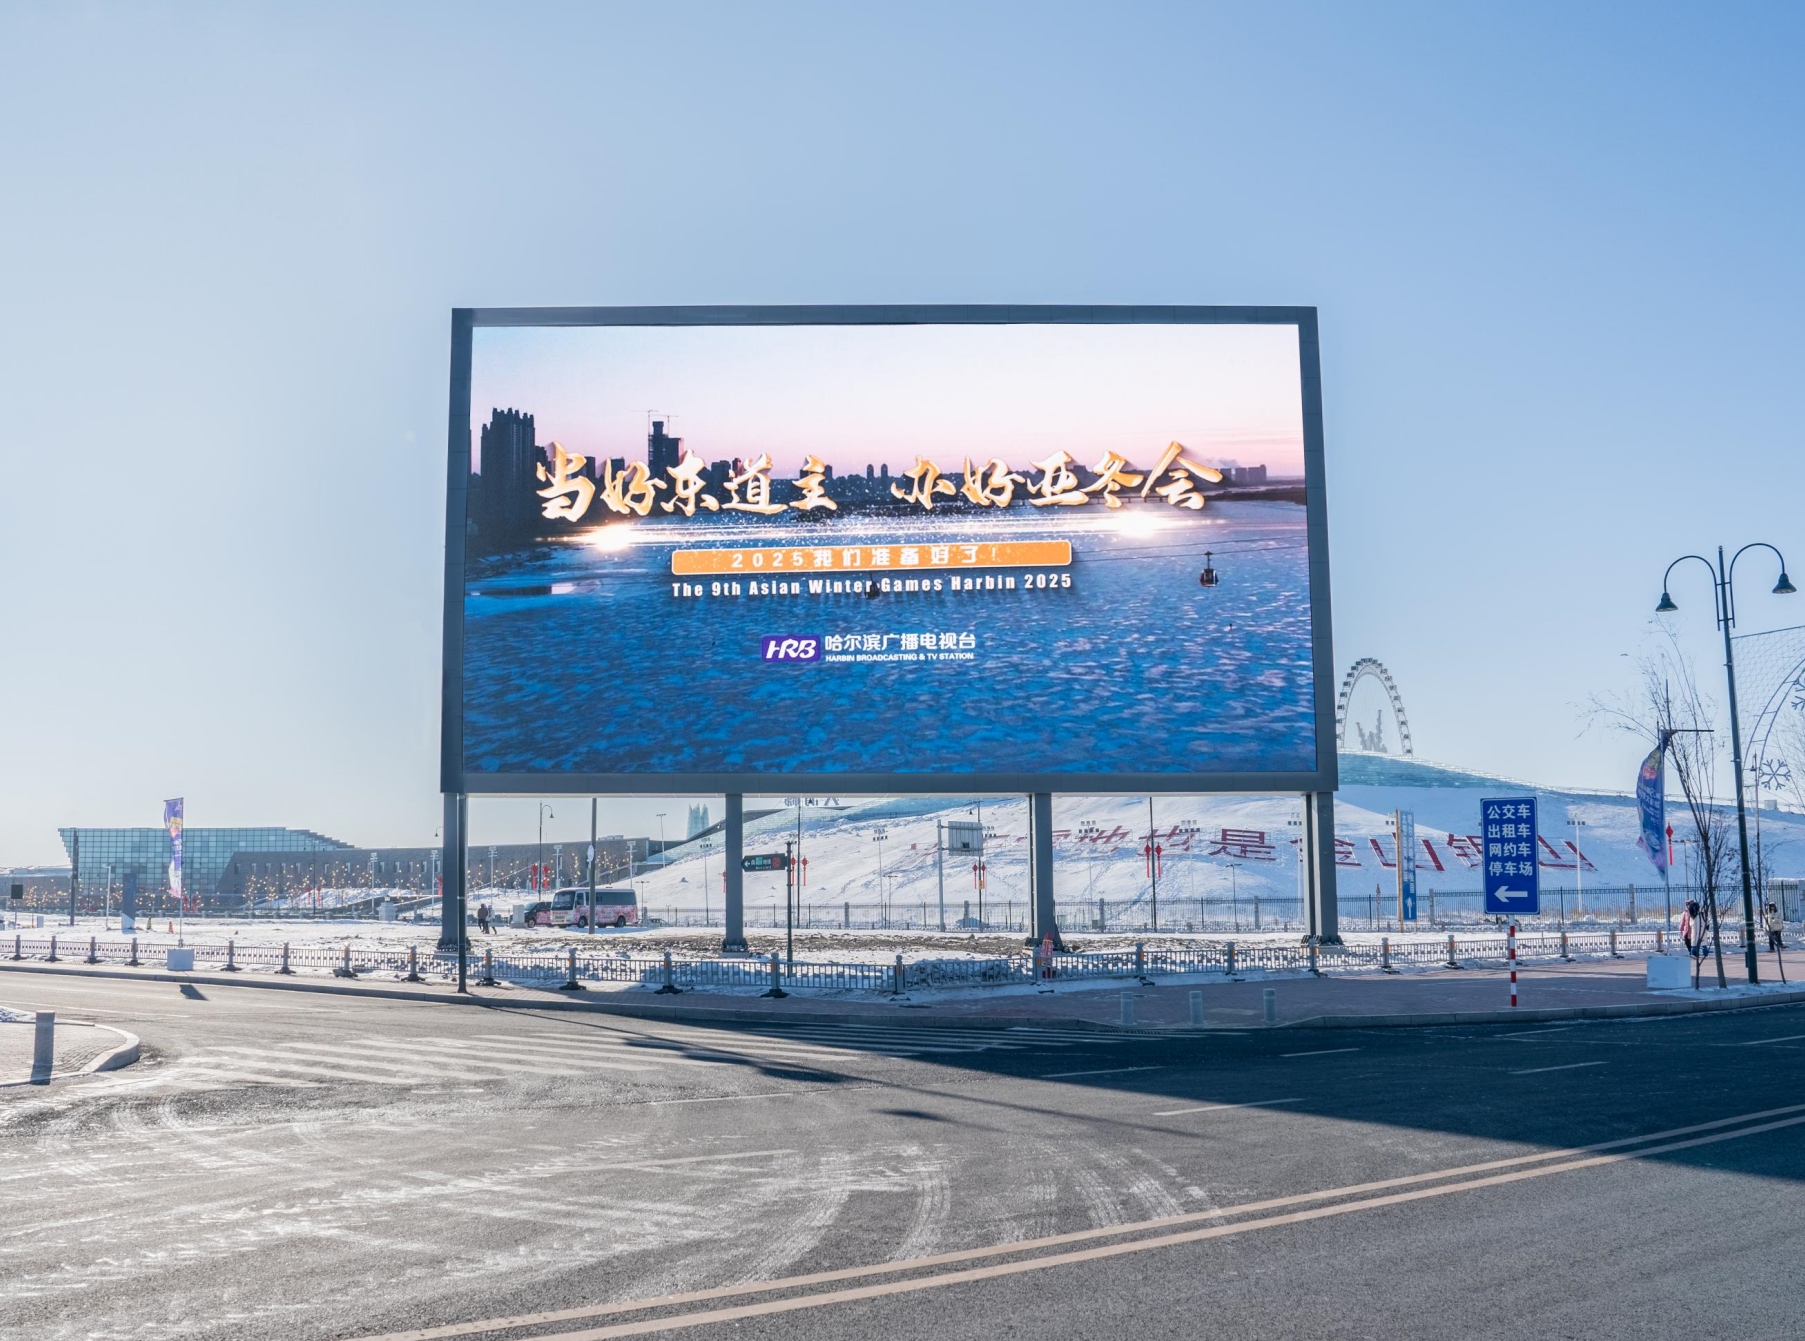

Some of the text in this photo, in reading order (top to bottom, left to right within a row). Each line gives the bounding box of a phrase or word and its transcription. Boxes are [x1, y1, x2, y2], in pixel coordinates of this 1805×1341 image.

[536, 440, 1224, 522] 当好东道主 办好亚冬会
[672, 573, 1072, 597] The 9th Asian Winter Games Harbin 2025
[765, 638, 817, 659] HRB
[824, 632, 976, 651] 哈尔滨广播电视台
[825, 652, 974, 662] HARBIN BROADCASTING & TV STATION
[1486, 803, 1531, 819] 公交车
[1487, 822, 1532, 839] 出租车
[1488, 841, 1532, 857] 网约车
[1488, 861, 1533, 877] 停车场
